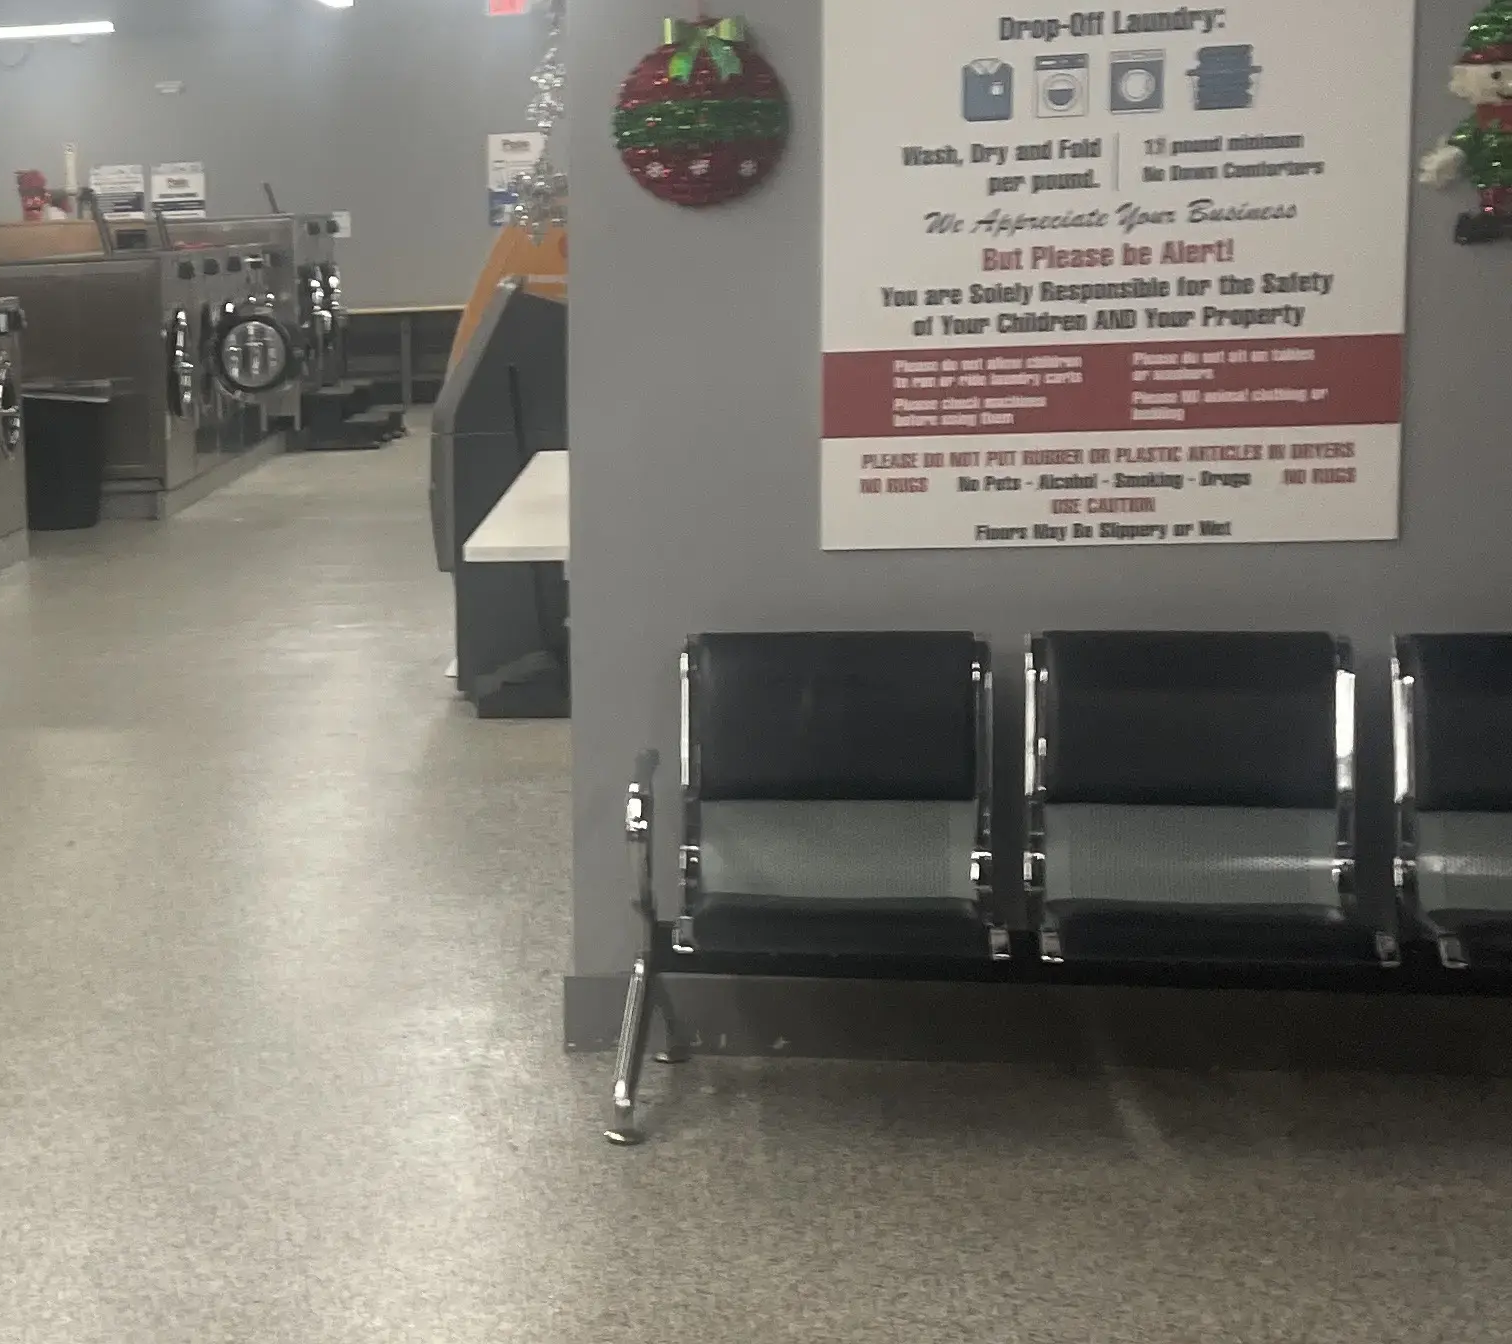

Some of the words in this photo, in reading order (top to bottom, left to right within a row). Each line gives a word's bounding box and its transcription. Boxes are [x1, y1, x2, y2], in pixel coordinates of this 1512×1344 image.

[999, 11, 1104, 42] Drop-Off
[1113, 6, 1225, 34] Laundry:
[900, 144, 963, 166] Wash,
[970, 142, 1008, 165] Dry
[1015, 140, 1052, 161] and
[1058, 138, 1102, 158] Fold
[988, 175, 1025, 195] per
[1032, 169, 1101, 193] pound.
[923, 211, 964, 233] We
[969, 208, 1109, 237] Appreciate
[1115, 202, 1176, 233] Your
[1186, 198, 1297, 223] Business
[982, 247, 1023, 271] But
[1031, 245, 1114, 269] Please
[1122, 242, 1152, 266] be
[1160, 238, 1234, 264] Alert!
[881, 286, 918, 306] You
[925, 288, 962, 305] are
[969, 282, 1033, 304] Solely
[1039, 276, 1170, 304] Responsible
[1177, 276, 1212, 296] for
[1219, 274, 1254, 295] the
[1261, 272, 1333, 295] Safety
[913, 316, 933, 336] of
[941, 315, 990, 335] Your
[997, 312, 1087, 333] Children
[1092, 309, 1137, 330] AND
[1145, 307, 1195, 328] Your
[1201, 304, 1306, 328] Property
[861, 453, 918, 469] PLEASE
[923, 453, 944, 468] DO
[950, 452, 980, 468] NOT
[985, 450, 1017, 467] PUT
[1090, 448, 1111, 464] OR
[1115, 446, 1182, 463] PLASTIC
[1188, 444, 1262, 462] ARTICLES
[1290, 442, 1355, 459] DRYERS
[957, 476, 979, 492] No
[984, 475, 1021, 491] Pets
[1037, 473, 1098, 490] Alcohol
[1114, 472, 1183, 489] Smoking
[1199, 470, 1251, 488] Drugs
[1051, 498, 1082, 514] USE
[1087, 497, 1156, 514] CAUTION
[975, 525, 1027, 541] Floors
[1033, 523, 1067, 541] May
[1099, 521, 1168, 540] Slippery
[1173, 523, 1194, 536] or
[1198, 521, 1231, 536] Wet
